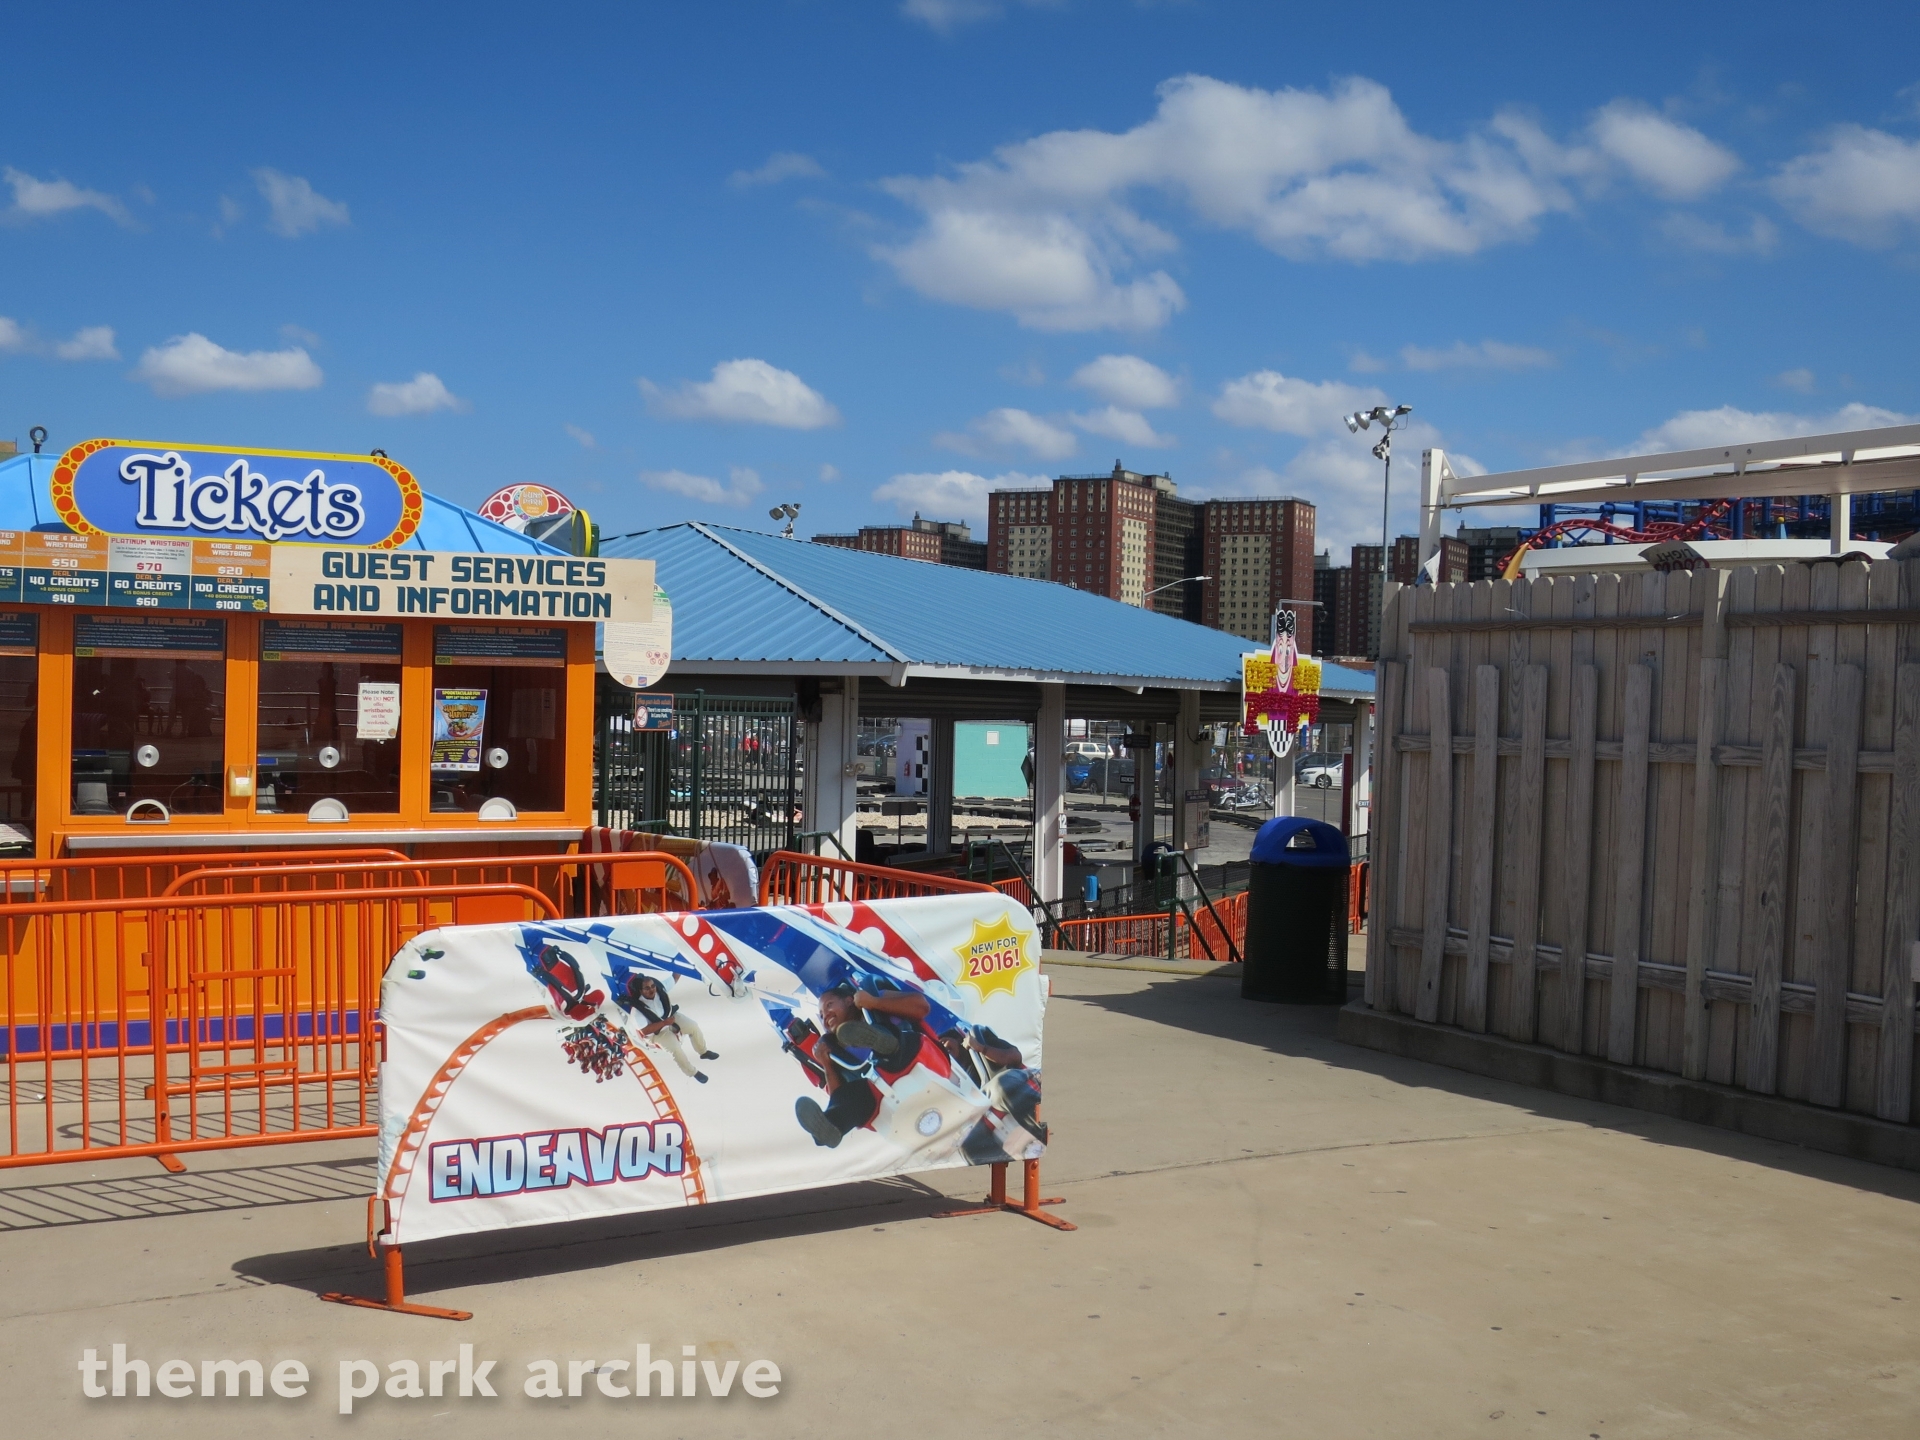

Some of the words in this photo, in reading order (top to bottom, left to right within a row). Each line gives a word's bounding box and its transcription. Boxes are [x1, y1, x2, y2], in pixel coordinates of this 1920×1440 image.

[121, 453, 363, 539] Tickets
[45, 541, 88, 549] WRISTBAND
[1656, 548, 1694, 562] LIGHT
[52, 558, 78, 568] $50
[137, 562, 162, 572] $70
[323, 550, 435, 581] GUEST
[452, 556, 607, 587] SERVICES
[218, 566, 243, 576] $20
[30, 576, 46, 586] 40
[50, 577, 100, 588] CREDITS
[114, 580, 130, 589] 60
[134, 581, 182, 591] CREDITS
[195, 583, 213, 592] 100
[218, 584, 264, 594] CREDITS
[52, 594, 75, 603] $40
[136, 597, 158, 607] $60
[315, 582, 381, 612] AND
[397, 586, 612, 618] INFORMATION
[216, 600, 242, 610] $100
[971, 941, 994, 955] NEW
[996, 936, 1017, 950] FOR
[968, 948, 1020, 978] 2016!
[429, 1120, 687, 1203] ENDEAVOR
